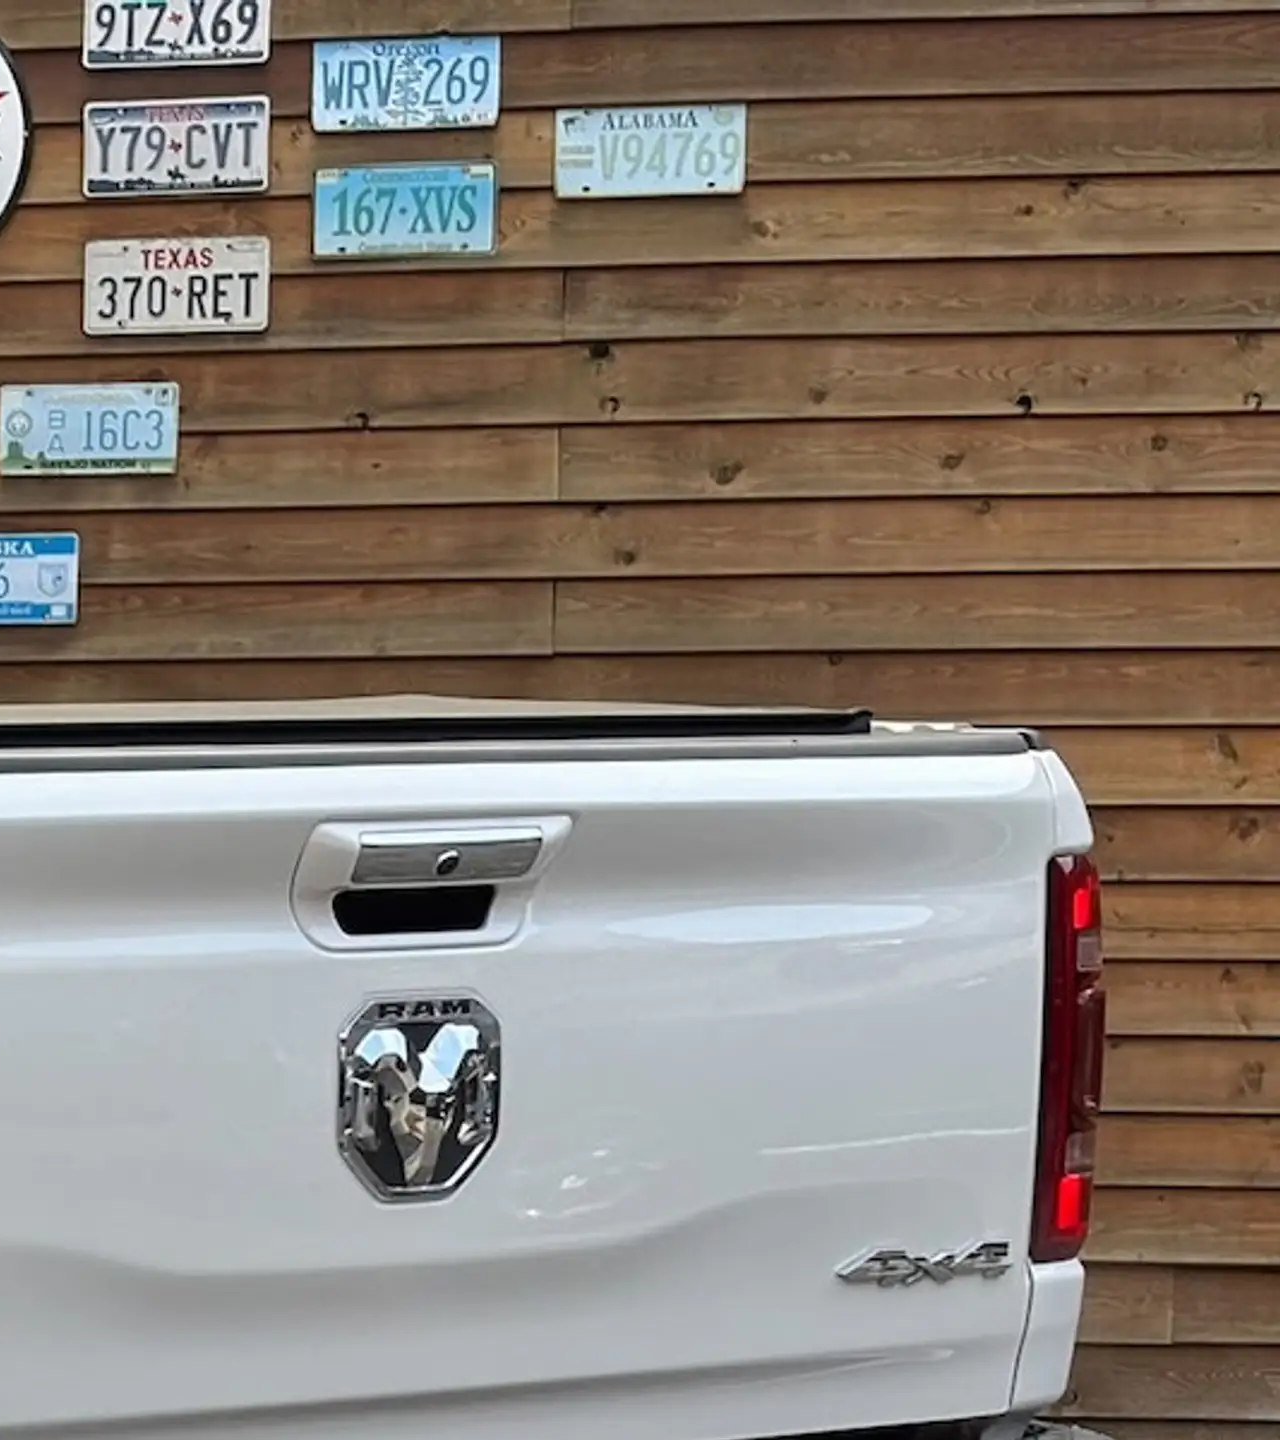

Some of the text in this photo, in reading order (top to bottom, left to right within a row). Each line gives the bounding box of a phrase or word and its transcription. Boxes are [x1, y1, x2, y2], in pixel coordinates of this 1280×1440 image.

[96, 0, 259, 47] 9TZ X69
[322, 56, 490, 111] WRV 269
[601, 109, 699, 131] ALABAMA
[96, 121, 259, 173] Y79 CVT
[598, 129, 741, 181] V94769
[141, 247, 214, 270] TEXAS
[97, 271, 259, 320] 370 RET
[82, 409, 164, 452] 16C3
[377, 999, 472, 1019] RAM
